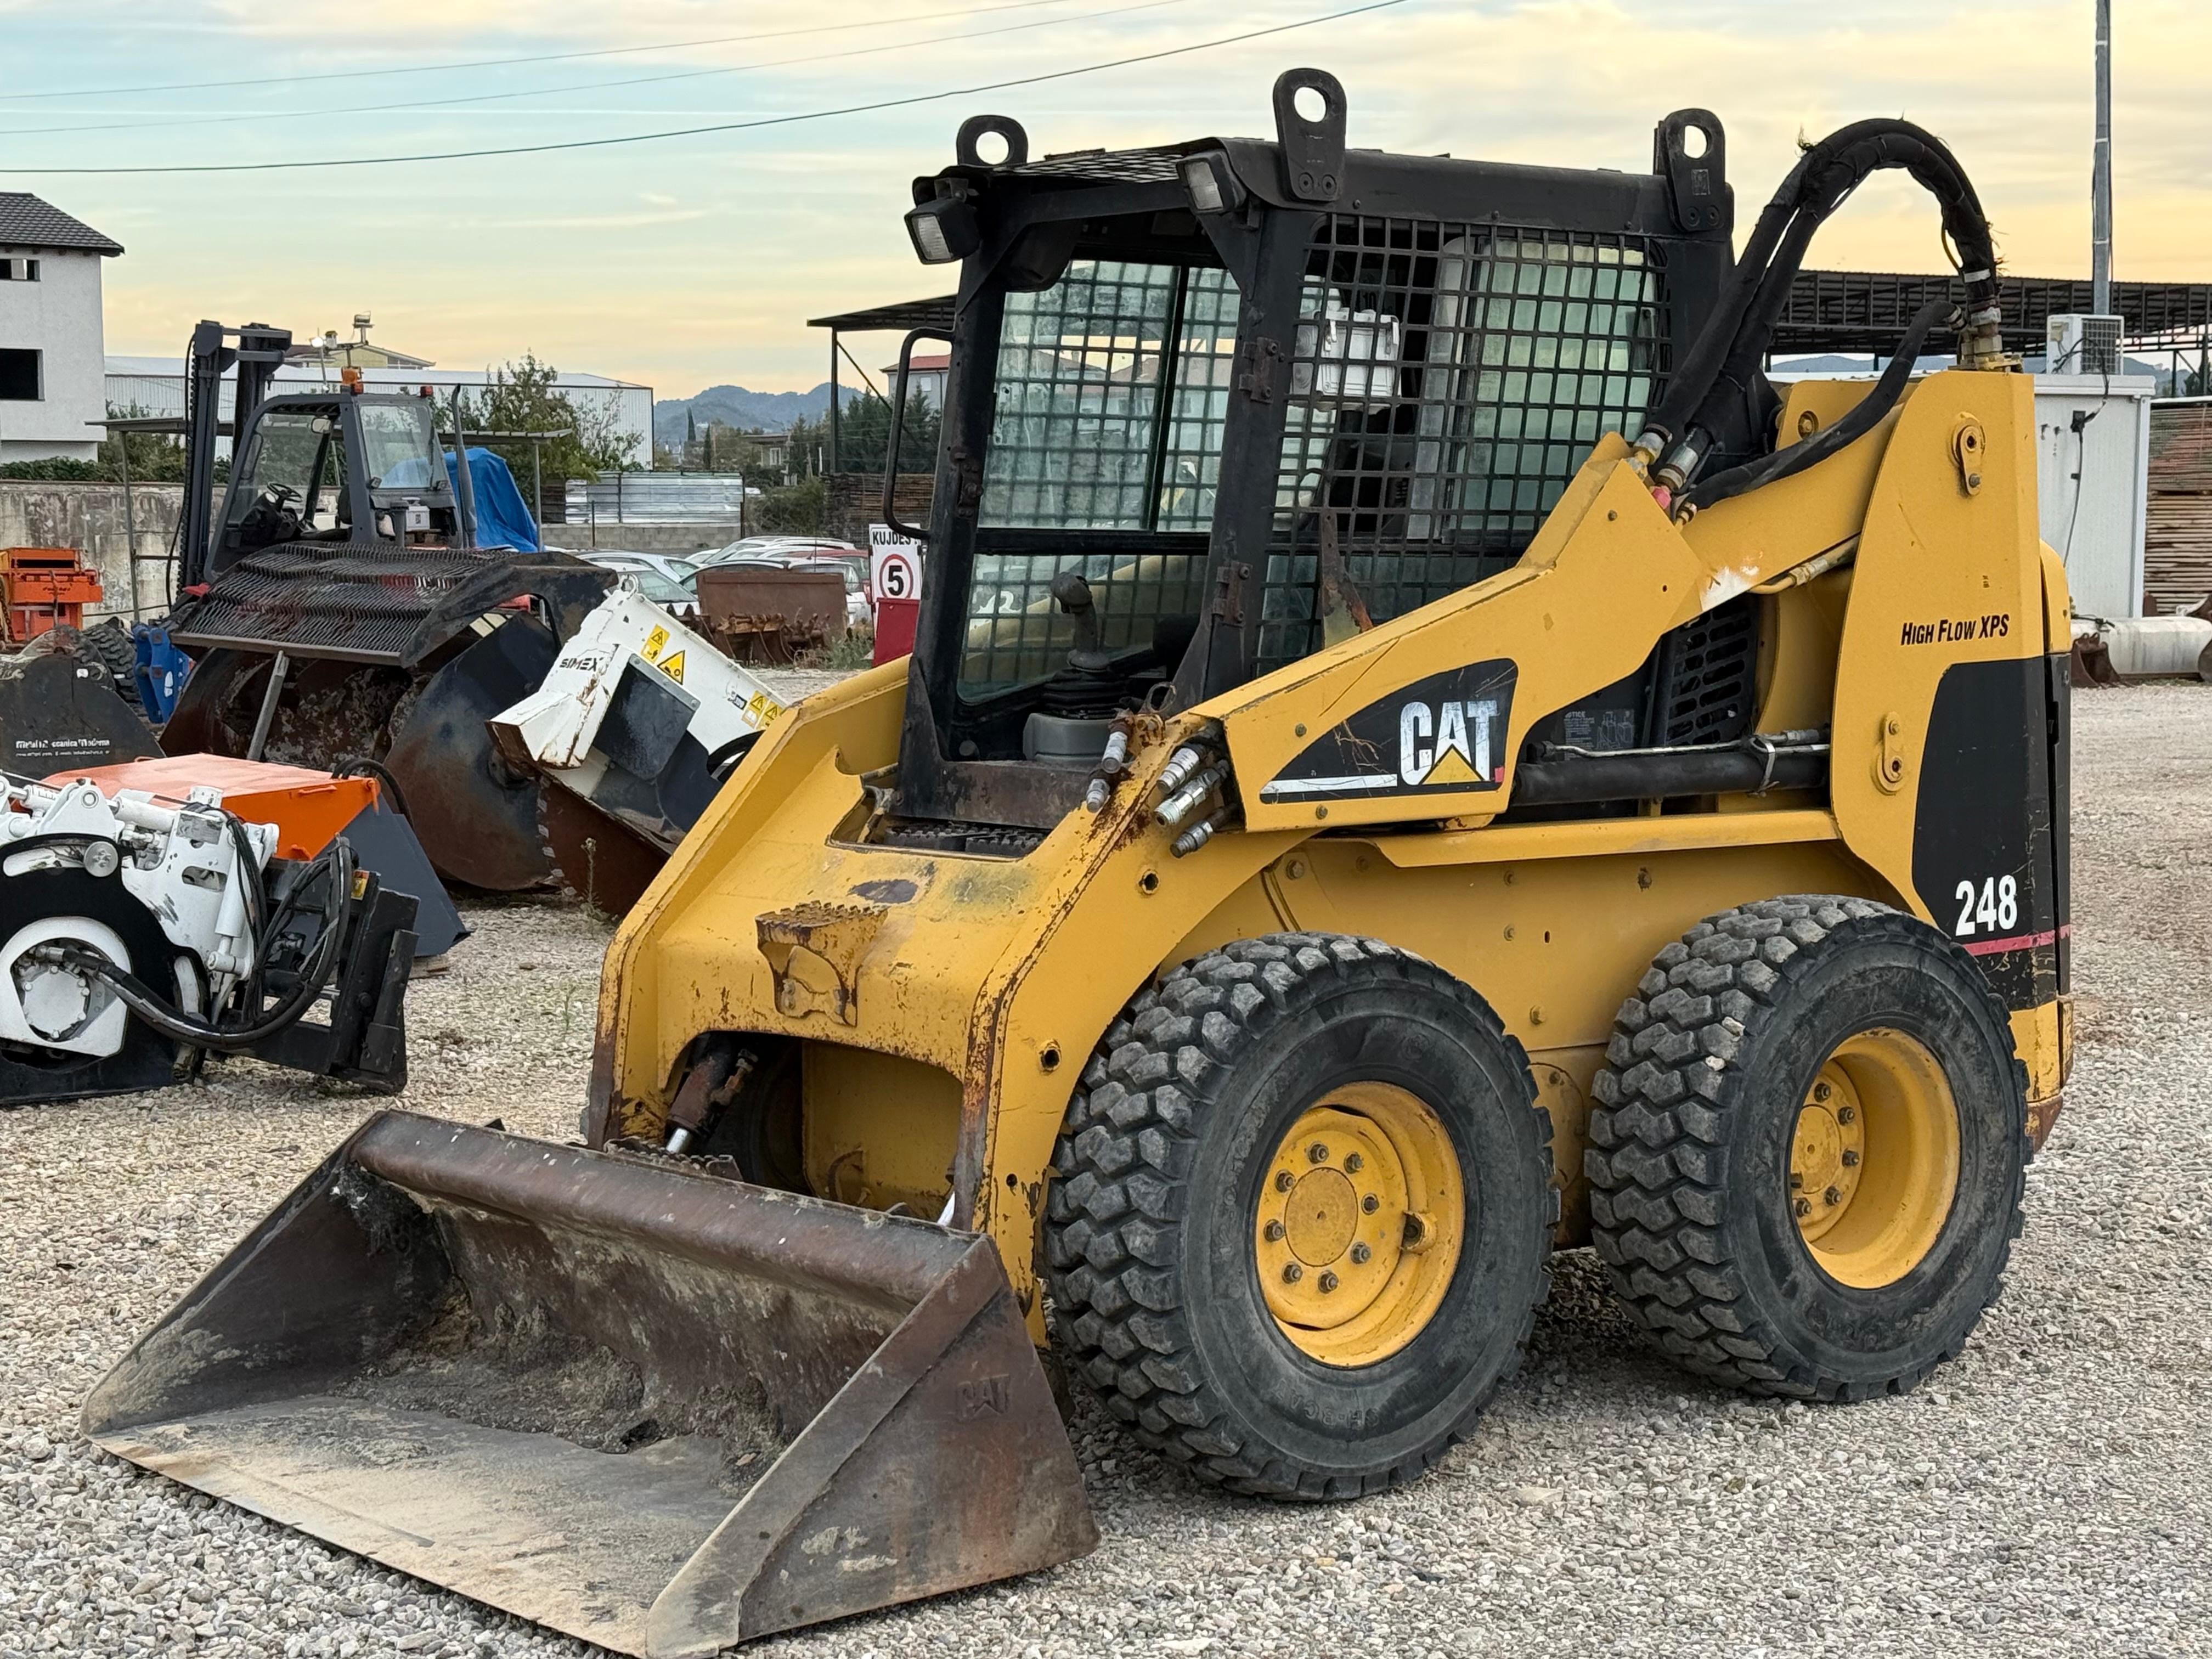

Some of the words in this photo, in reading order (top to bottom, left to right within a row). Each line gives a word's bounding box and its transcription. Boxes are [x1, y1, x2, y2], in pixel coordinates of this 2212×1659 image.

[888, 565, 904, 596] 5
[1979, 614, 2010, 639] XPS
[559, 657, 603, 672] SIMEX
[1400, 700, 1497, 785] CAT
[1955, 874, 2017, 936] 248
[957, 1373, 1009, 1420] CAT
